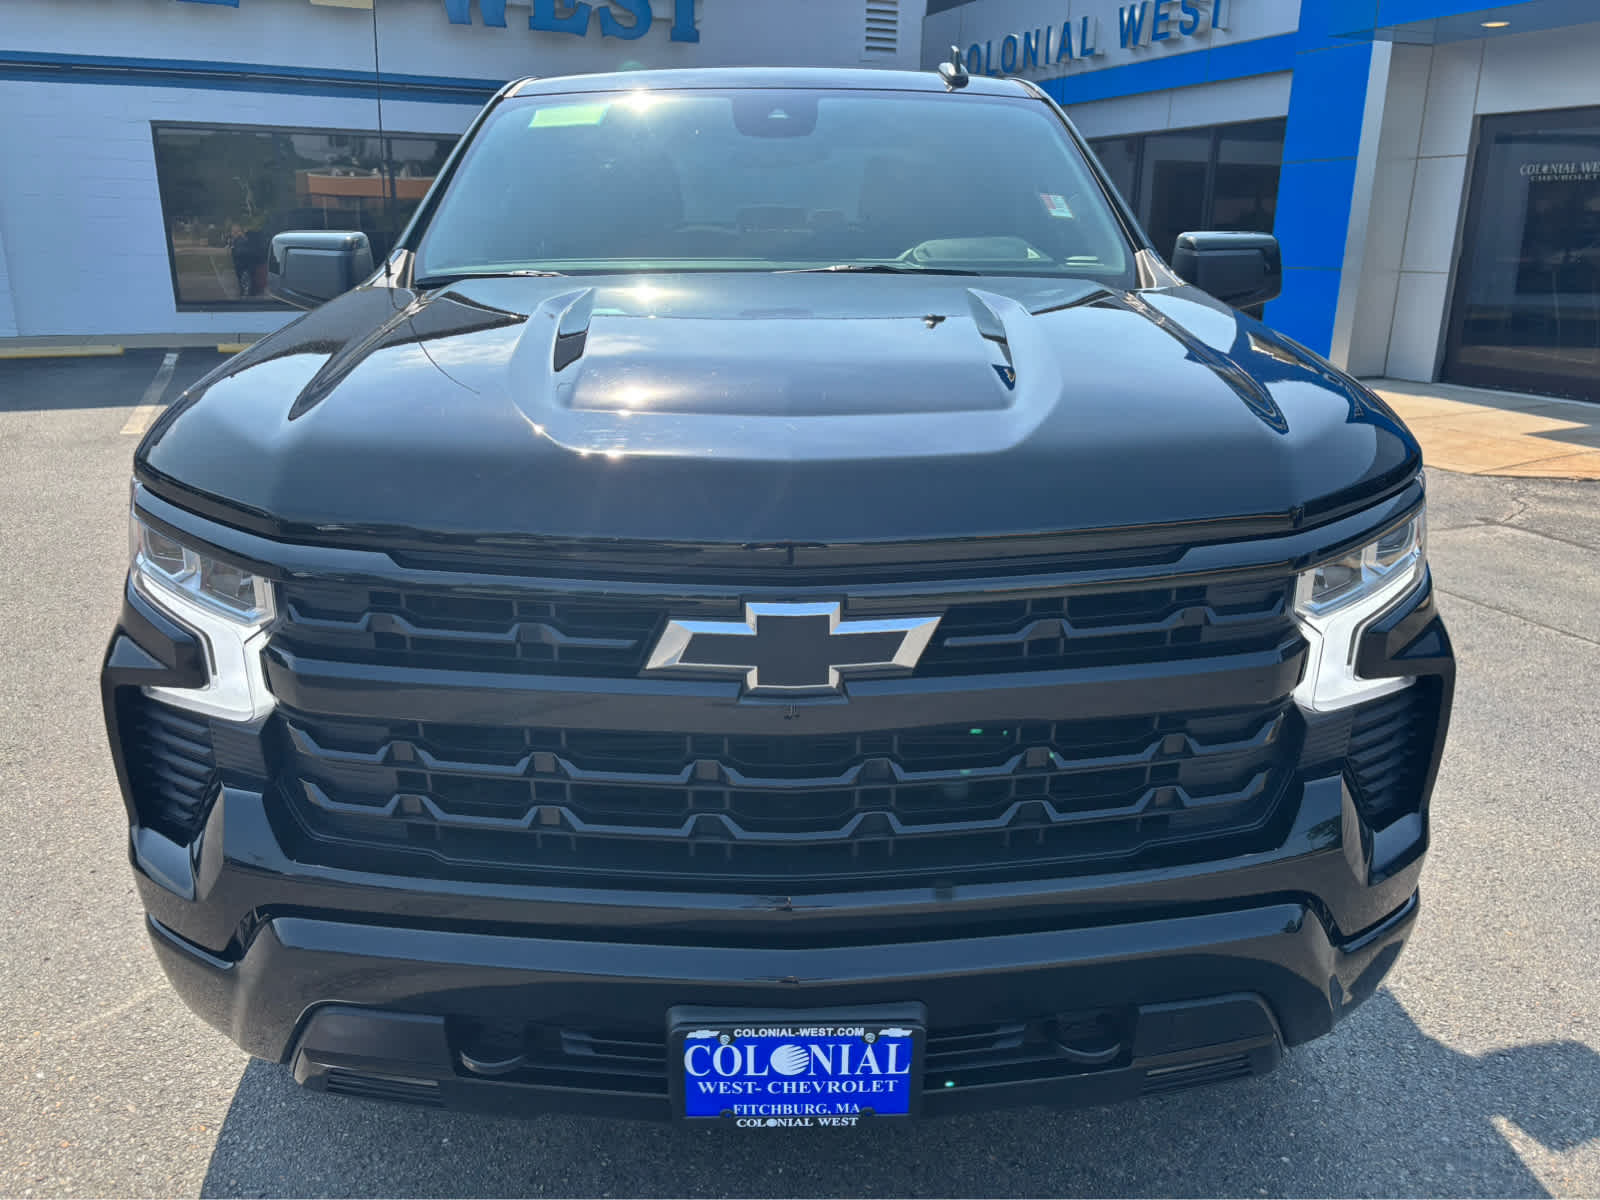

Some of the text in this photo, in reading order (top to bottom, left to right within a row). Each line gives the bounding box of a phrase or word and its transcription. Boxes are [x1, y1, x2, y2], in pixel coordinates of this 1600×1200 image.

[957, 16, 1096, 76] OLONIAL
[1520, 162, 1577, 176] COLONIAL
[733, 1027, 865, 1038] COLONIAL-WEST.COM
[684, 1043, 911, 1077] COLONIAL
[767, 1080, 899, 1094] CHEVROLET
[836, 1103, 860, 1113] MA
[736, 1117, 859, 1128] COLONIAL WEST
